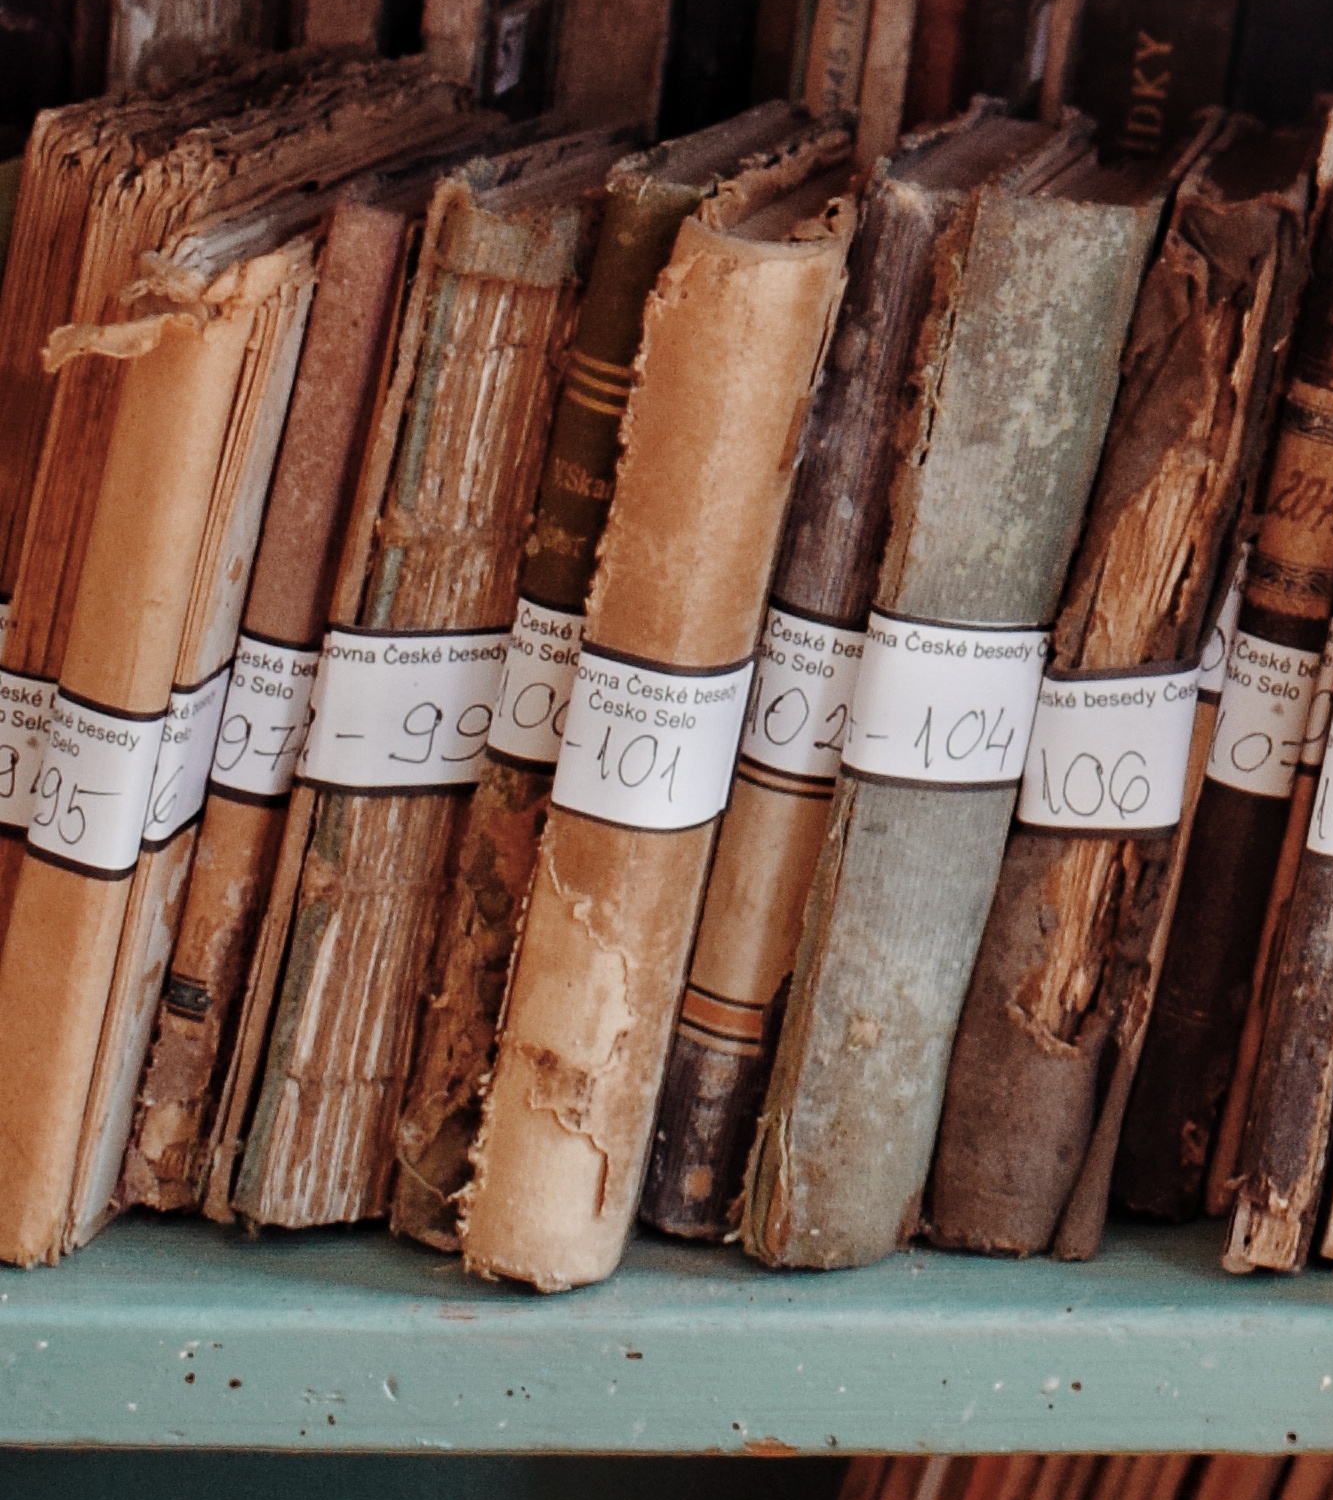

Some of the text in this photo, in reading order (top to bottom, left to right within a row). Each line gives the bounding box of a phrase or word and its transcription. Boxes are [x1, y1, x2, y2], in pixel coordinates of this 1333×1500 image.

[384, 644, 442, 664] České
[905, 630, 967, 658] České
[627, 674, 688, 704] České
[589, 688, 696, 731] Česko Selo
